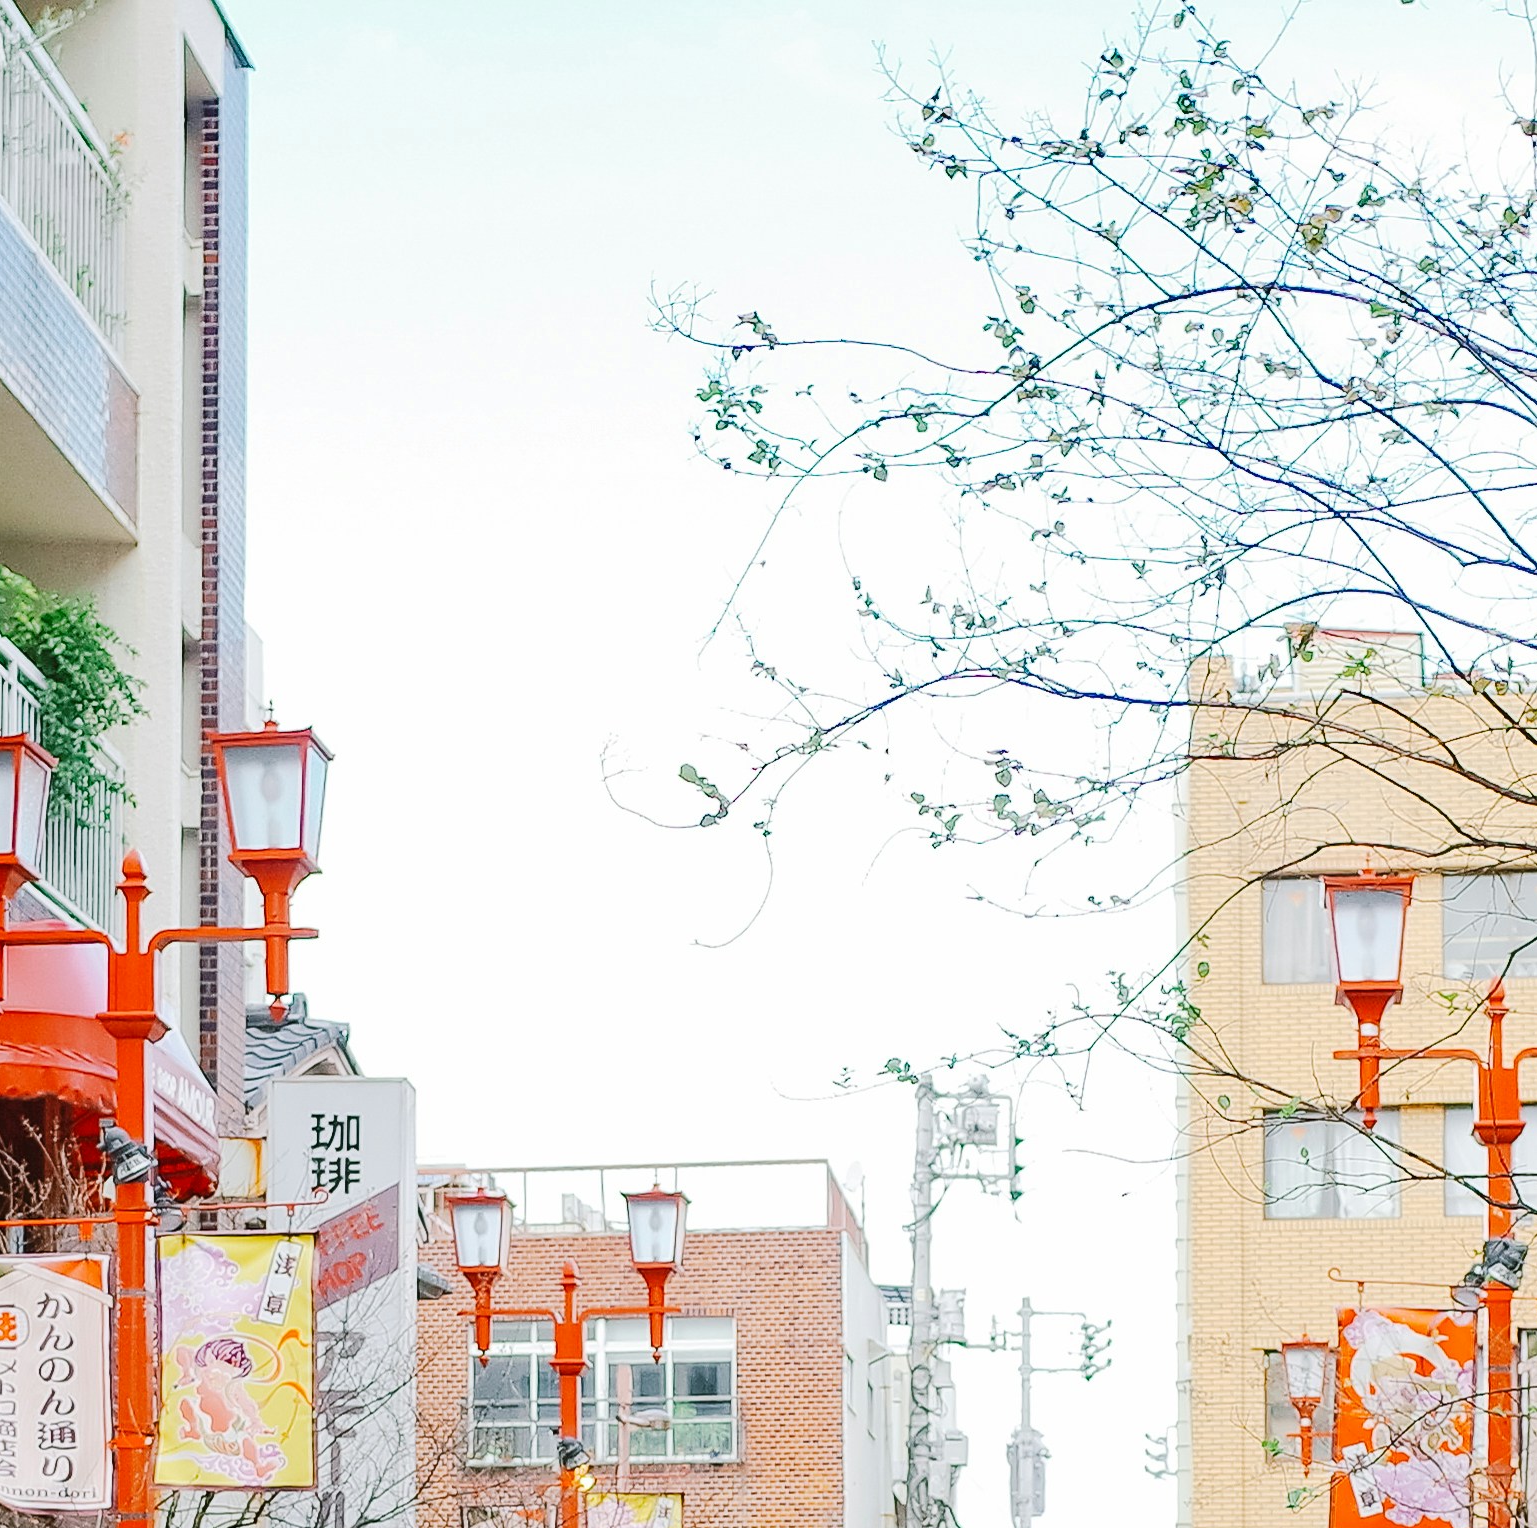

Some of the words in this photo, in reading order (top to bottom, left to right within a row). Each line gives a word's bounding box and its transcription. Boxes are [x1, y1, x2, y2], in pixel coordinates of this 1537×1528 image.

[310, 1113, 361, 1194] 珈琲
[264, 1252, 293, 1315] 浅草
[36, 1291, 78, 1484] かんのん通り
